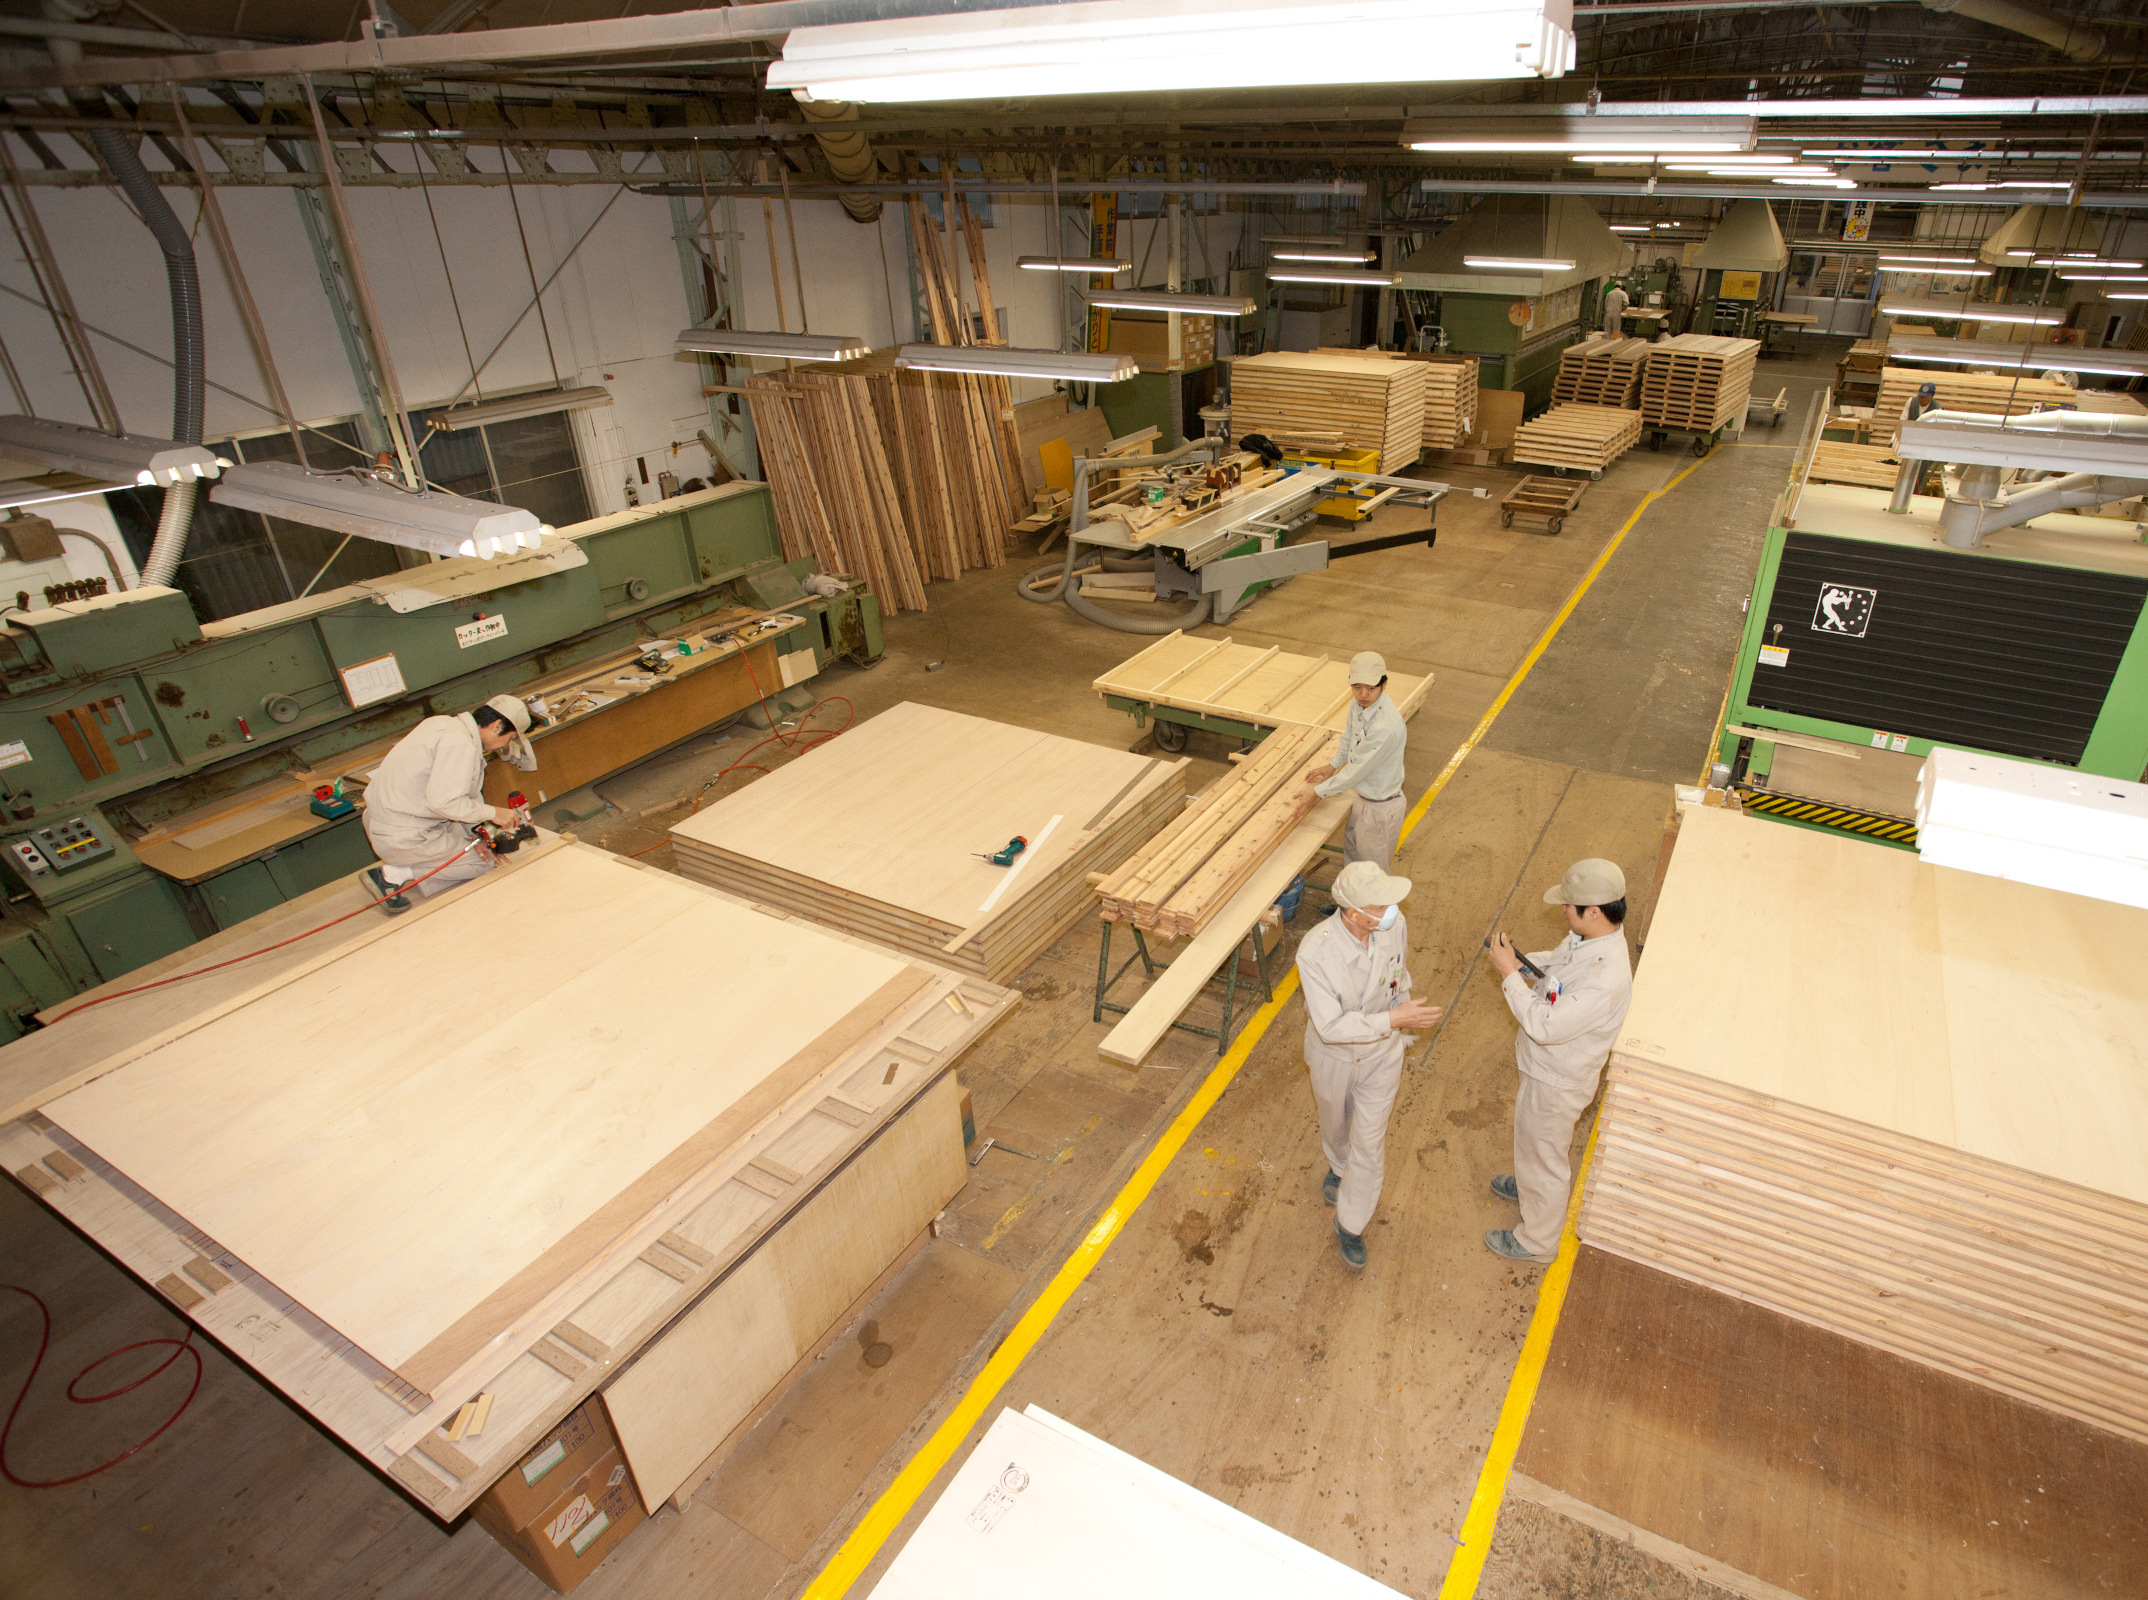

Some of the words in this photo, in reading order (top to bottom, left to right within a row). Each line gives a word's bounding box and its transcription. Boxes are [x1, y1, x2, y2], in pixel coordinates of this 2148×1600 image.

[1106, 206, 1115, 252] 作業前
[571, 1433, 585, 1448] 100
[615, 1503, 628, 1518] 100
